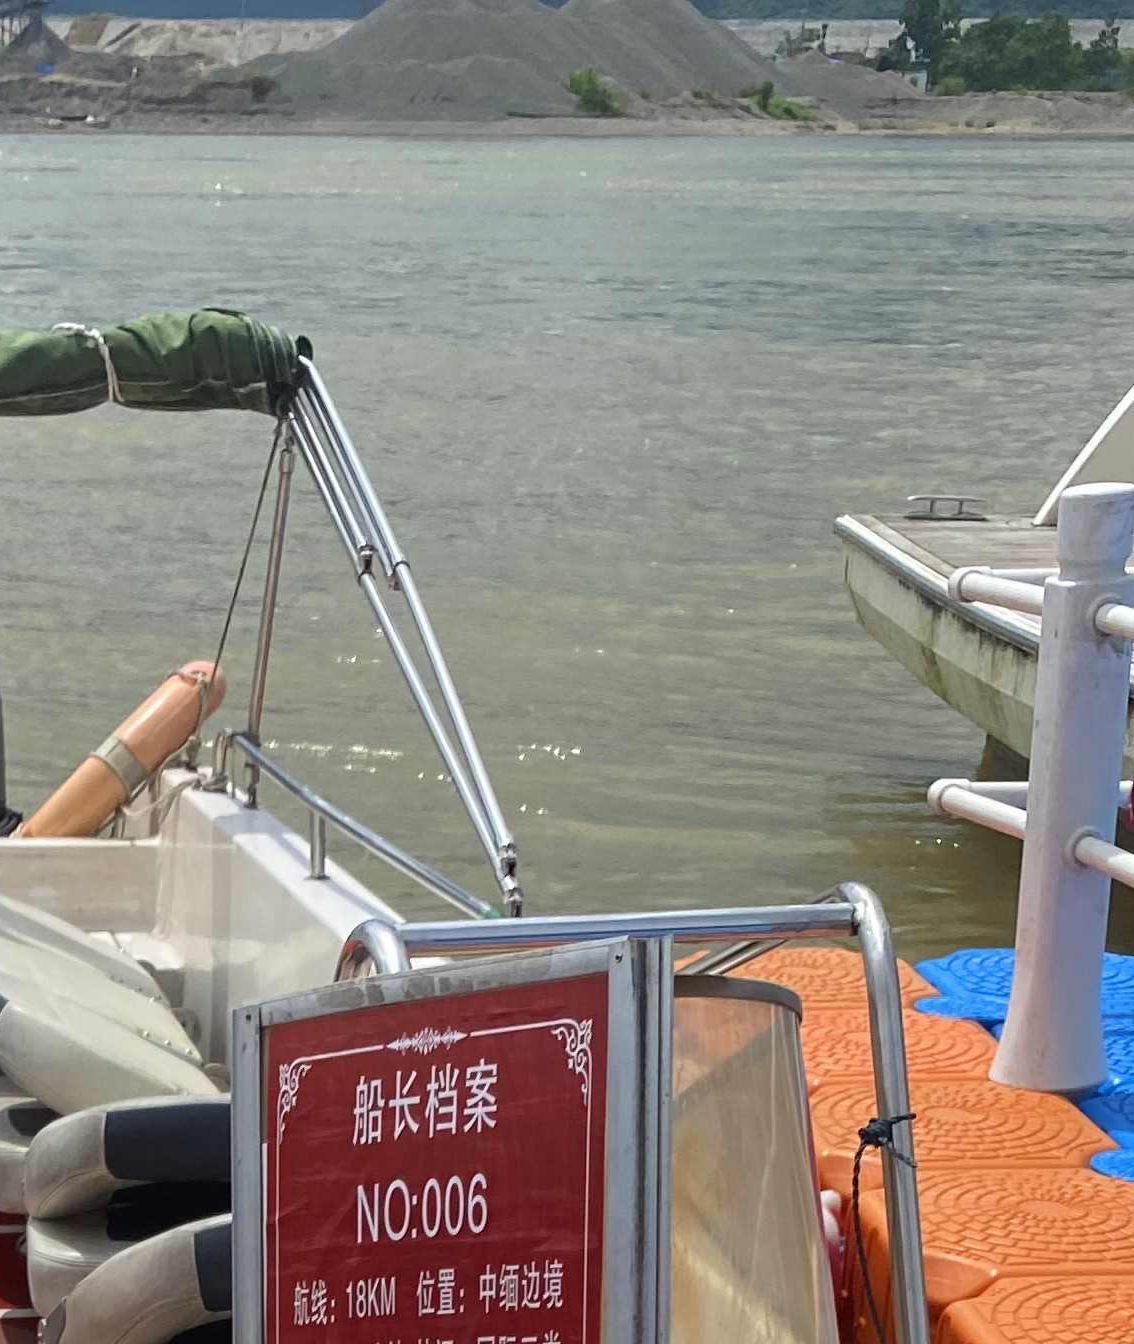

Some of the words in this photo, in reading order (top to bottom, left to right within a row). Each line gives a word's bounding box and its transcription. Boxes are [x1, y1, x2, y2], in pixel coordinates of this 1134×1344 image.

[352, 1060, 499, 1146] 船长档案
[356, 1173, 488, 1244] NO:006
